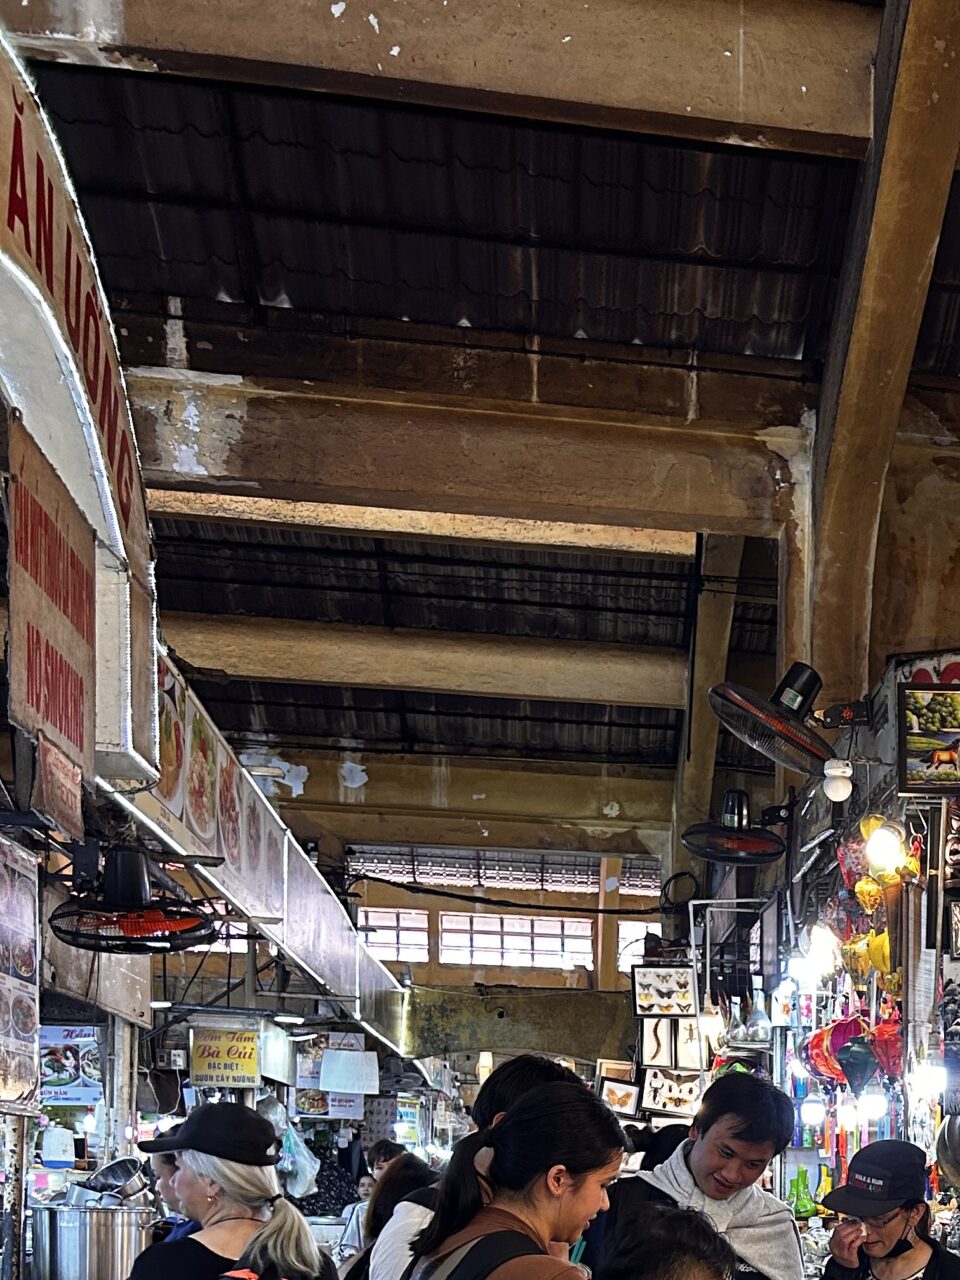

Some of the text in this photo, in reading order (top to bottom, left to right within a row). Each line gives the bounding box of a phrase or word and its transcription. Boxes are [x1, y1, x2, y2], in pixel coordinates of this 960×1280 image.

[7, 86, 54, 295] ĂN
[65, 222, 134, 535] UỐNG
[26, 621, 84, 754] NO SMOKING
[196, 1044, 222, 1059] Bà
[871, 1177, 884, 1187] RUN
